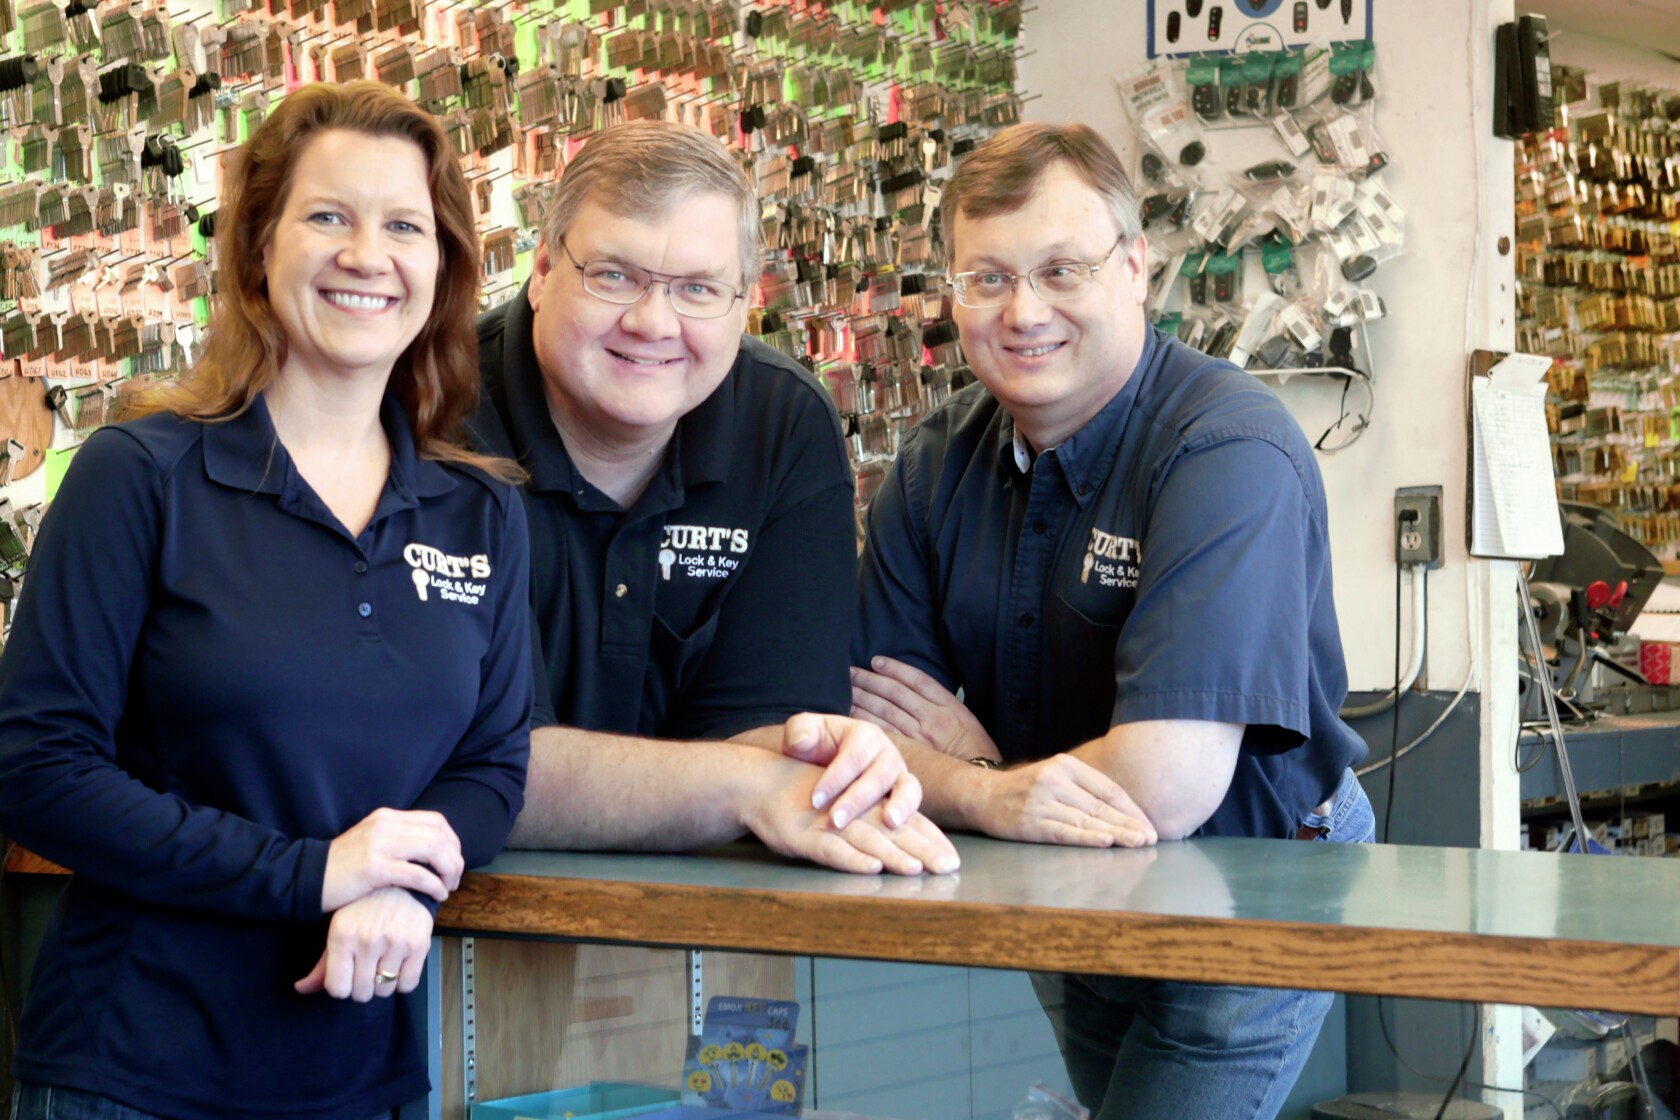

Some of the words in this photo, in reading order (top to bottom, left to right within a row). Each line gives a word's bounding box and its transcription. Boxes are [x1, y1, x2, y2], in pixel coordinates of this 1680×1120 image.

[403, 543, 492, 578] CURT'S
[678, 553, 705, 566] Lock
[707, 555, 716, 566] &
[718, 556, 739, 570] Key
[1094, 560, 1115, 576] Lock
[1116, 565, 1125, 577] &
[687, 565, 729, 578] Service
[430, 574, 454, 591] Lock
[454, 581, 464, 593] &
[464, 581, 486, 597] Key
[1099, 573, 1138, 588] Service
[440, 587, 480, 605] Service
[766, 1006, 789, 1017] CAPS
